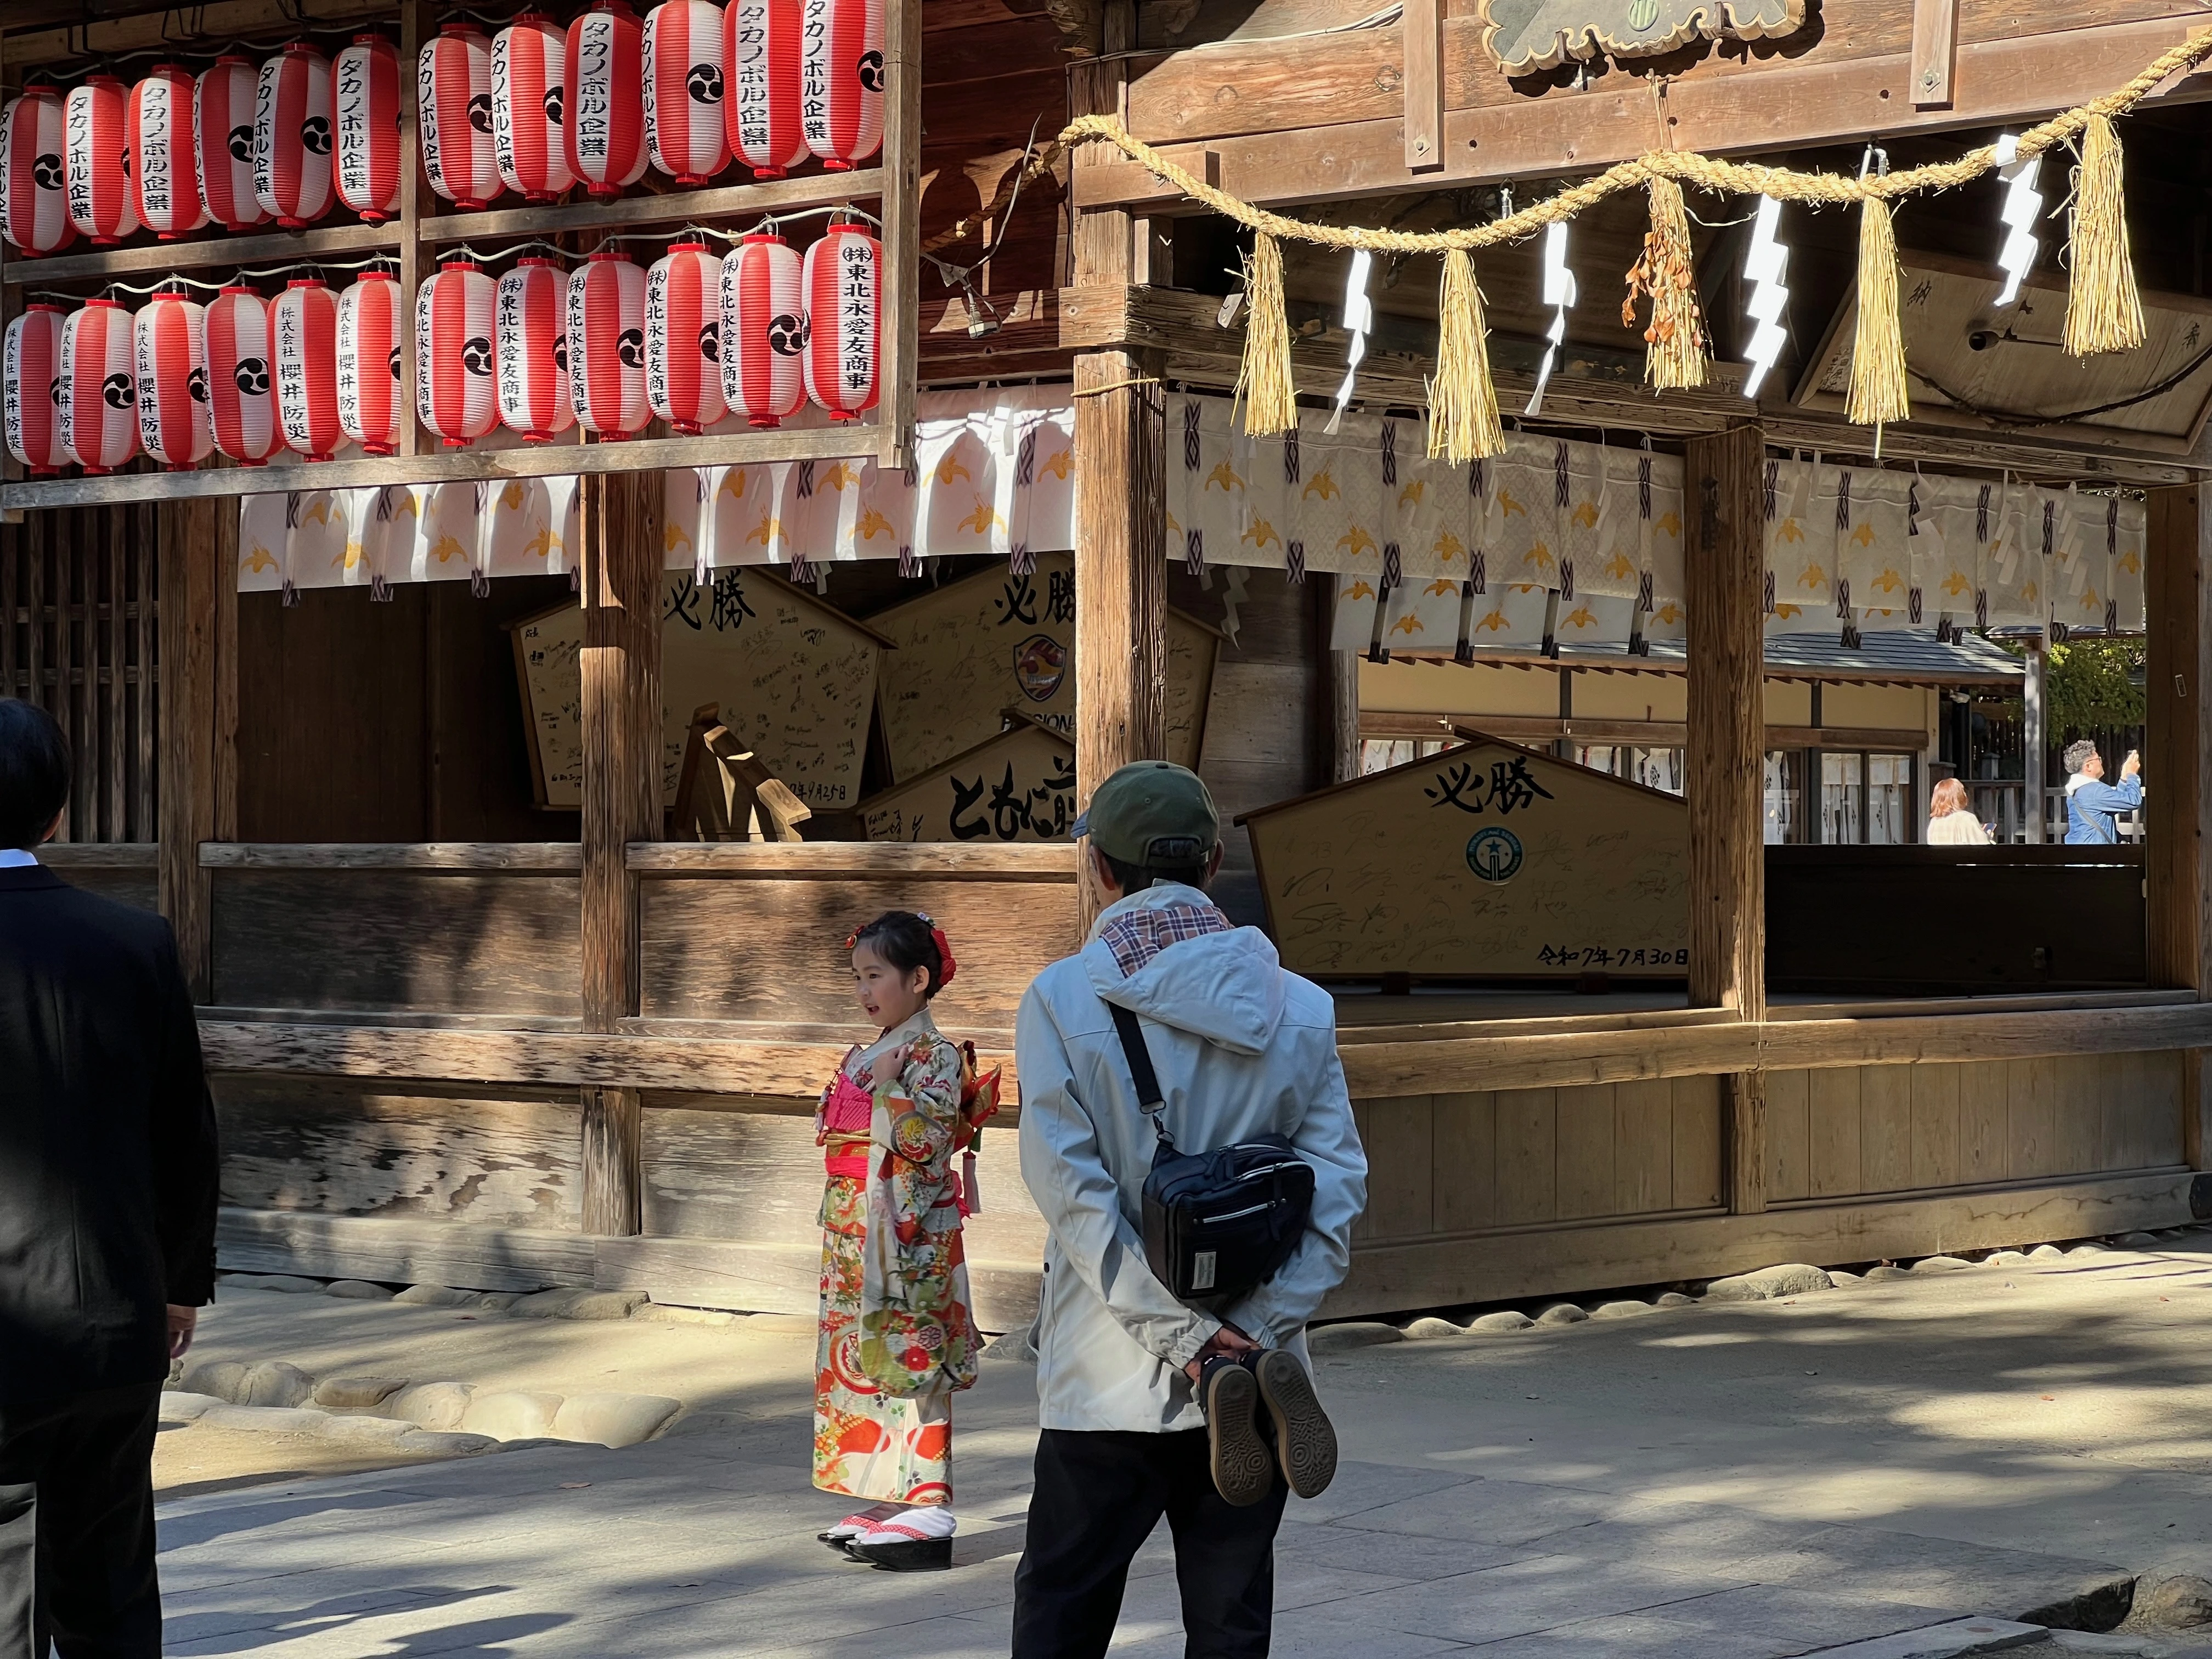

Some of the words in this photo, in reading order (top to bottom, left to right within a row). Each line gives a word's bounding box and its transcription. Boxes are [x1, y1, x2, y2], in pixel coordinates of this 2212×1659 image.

[253, 66, 275, 195] タカノボル企業
[340, 60, 366, 190] タカノボル企業
[419, 49, 442, 181] タカノボル企業
[491, 40, 515, 173] タカノボル企業
[579, 21, 610, 156] タカノボル企業
[641, 19, 659, 154] タカノボル企業
[738, 5, 770, 146] タカノボル企業
[803, 0, 827, 139] タカノボル企業
[70, 97, 92, 219] タカノボル企業
[143, 87, 169, 210] タカノボル企業
[663, 568, 756, 631] 必勝
[995, 569, 1075, 625] 必勝
[1424, 755, 1555, 815] 必勝
[1537, 943, 1688, 967] 令和7年7月30日
